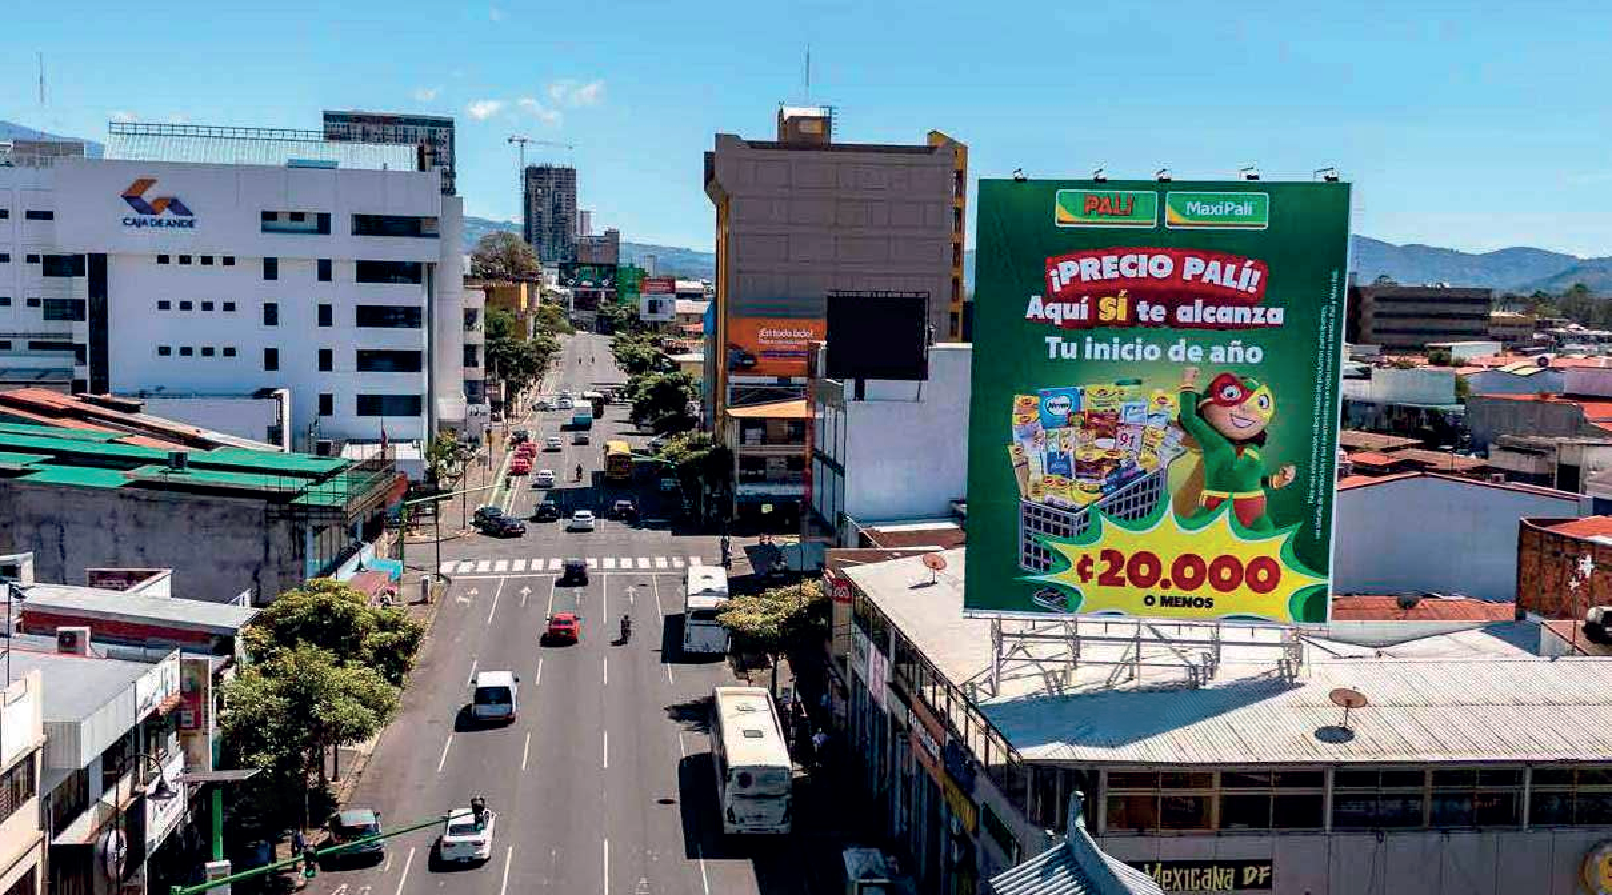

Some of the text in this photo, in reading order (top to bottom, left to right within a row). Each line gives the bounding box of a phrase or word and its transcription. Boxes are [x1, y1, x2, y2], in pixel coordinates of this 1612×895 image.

[122, 217, 149, 228] CAJA
[1050, 254, 1262, 293] ¡PRECIO PALÍ!
[1025, 289, 1285, 325] Aquí SÍ te alcanza
[1045, 336, 1264, 364] Tu inicio de año
[1144, 595, 1213, 608] O MENOS
[1243, 866, 1272, 884] DF
